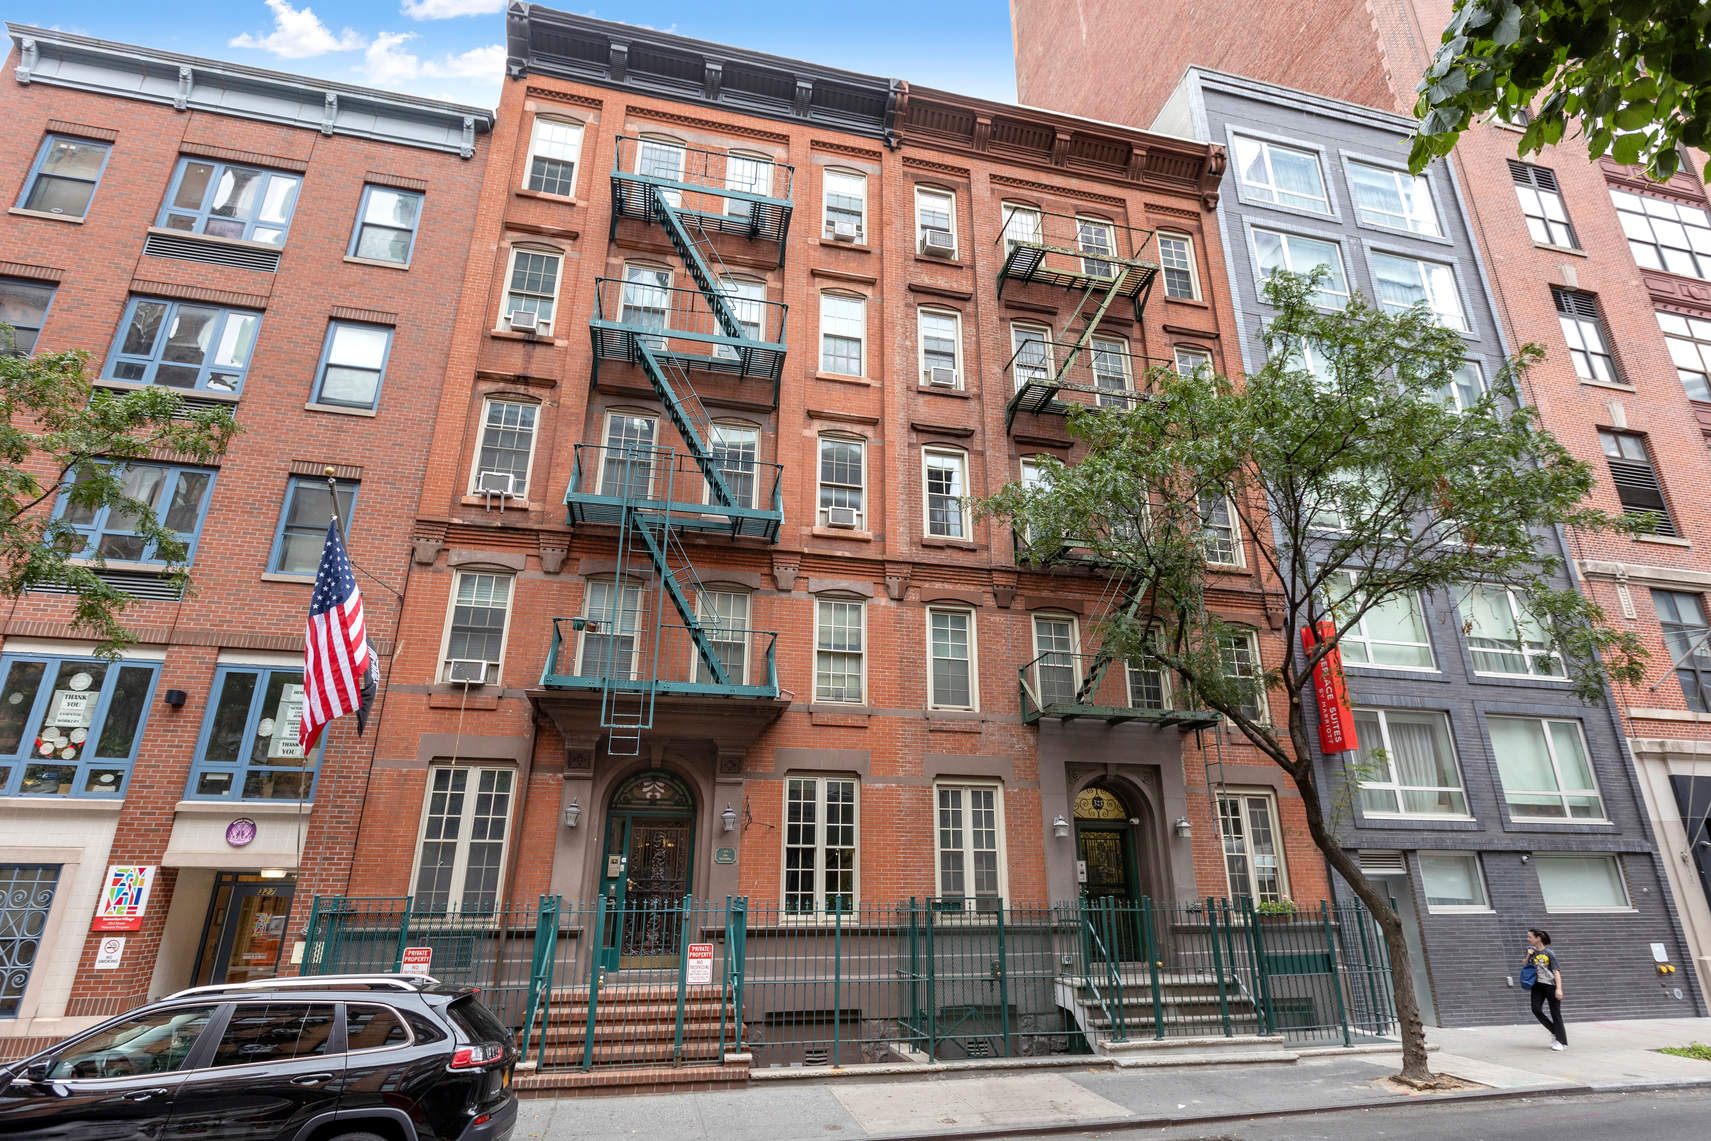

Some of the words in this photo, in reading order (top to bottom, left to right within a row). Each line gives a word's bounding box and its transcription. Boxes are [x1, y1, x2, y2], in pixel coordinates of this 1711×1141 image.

[1318, 688, 1325, 699] BY
[1321, 702, 1333, 744] MARRIOTT
[1329, 707, 1342, 743] SUITES
